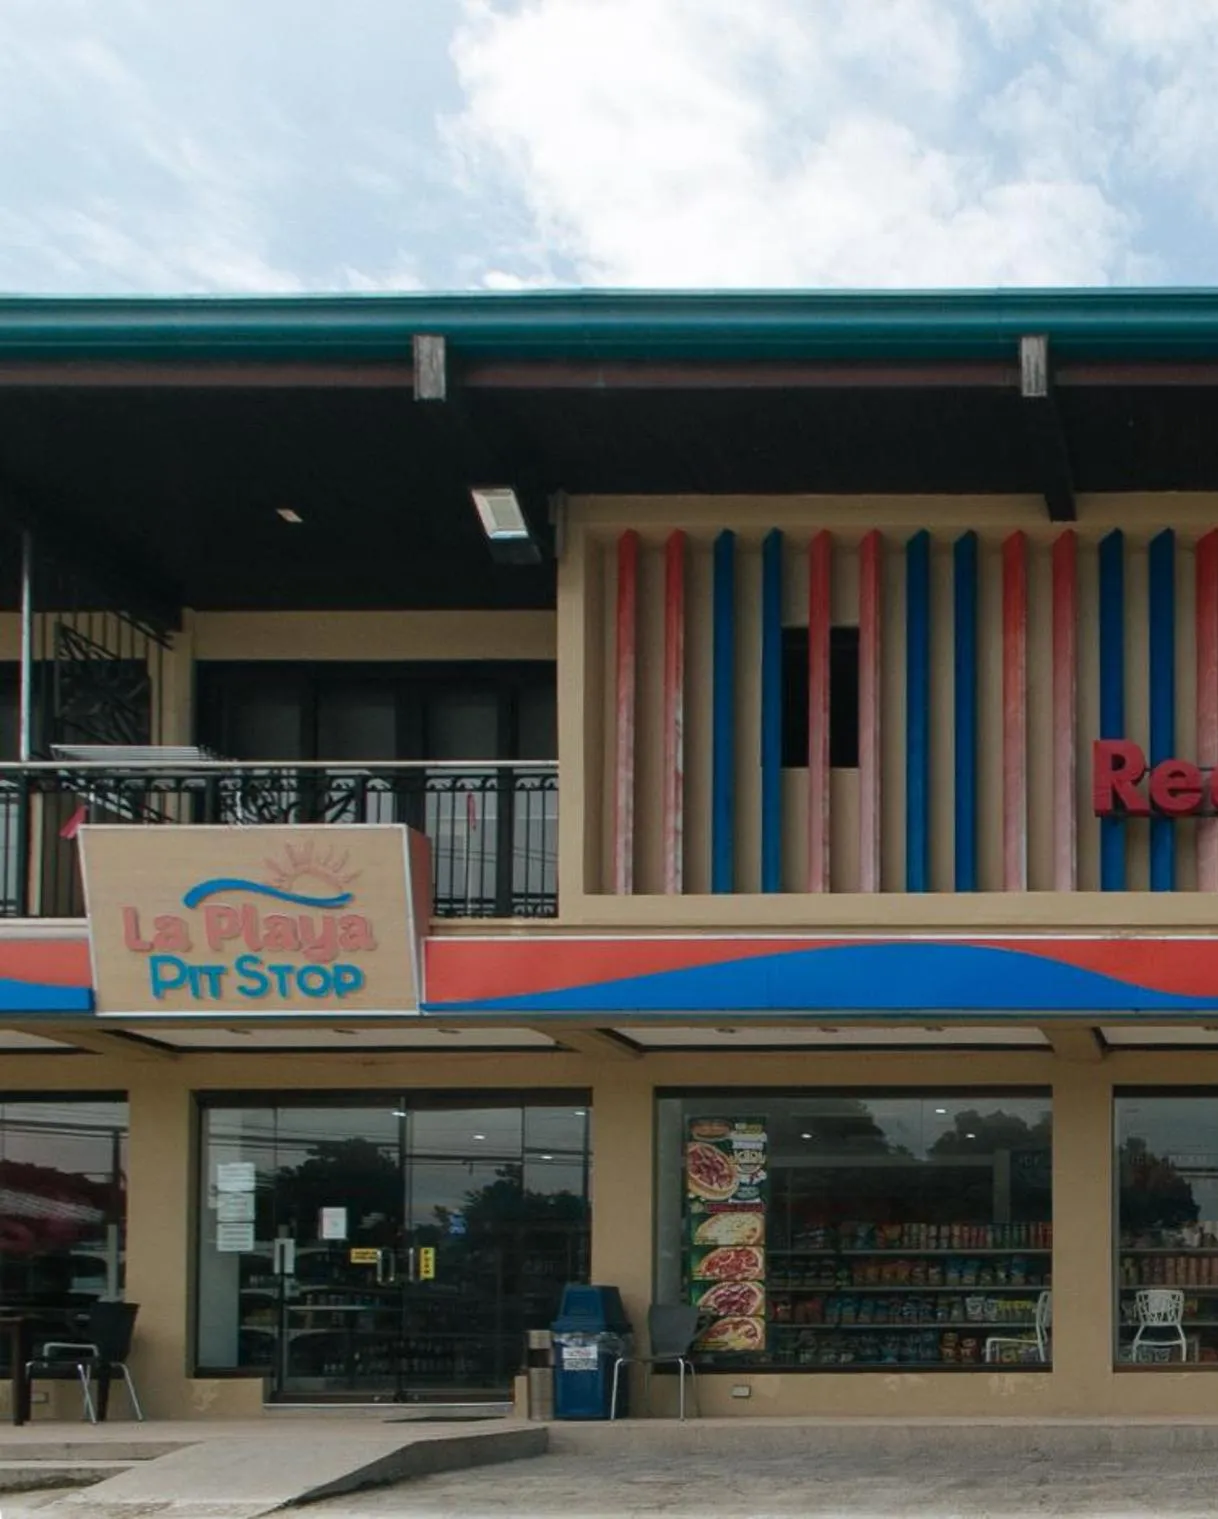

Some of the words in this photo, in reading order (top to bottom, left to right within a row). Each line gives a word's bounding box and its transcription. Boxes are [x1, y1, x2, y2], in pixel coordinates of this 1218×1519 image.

[121, 903, 194, 952] La
[203, 903, 377, 963] Playa
[235, 954, 364, 999] STOP
